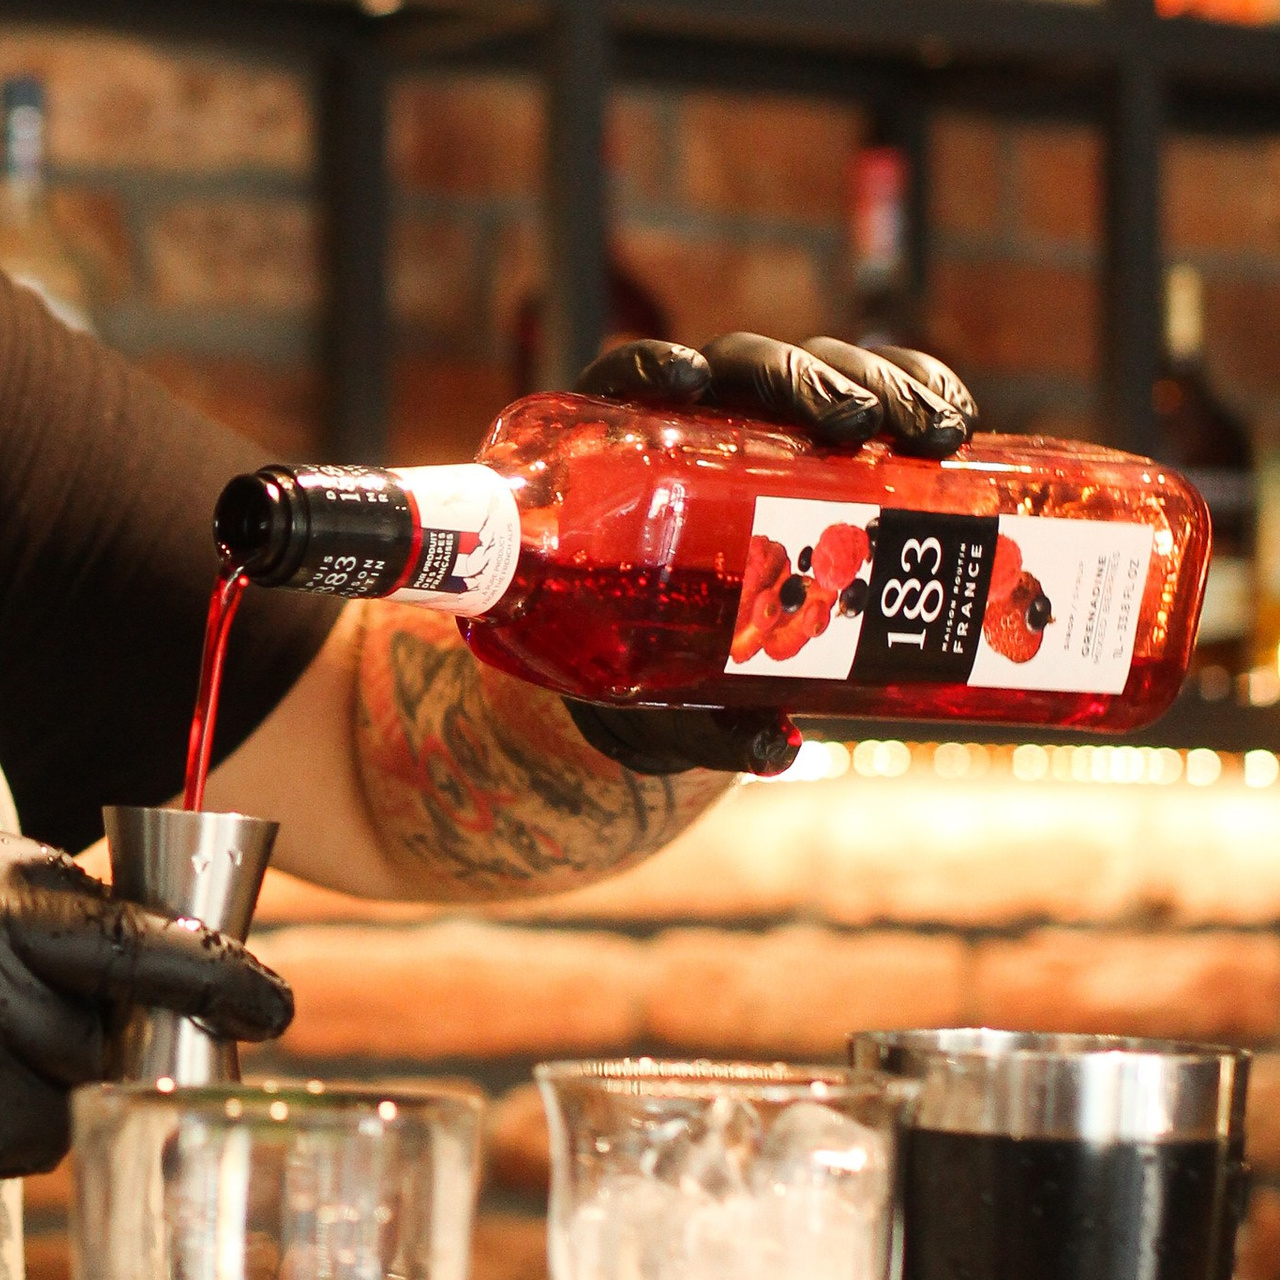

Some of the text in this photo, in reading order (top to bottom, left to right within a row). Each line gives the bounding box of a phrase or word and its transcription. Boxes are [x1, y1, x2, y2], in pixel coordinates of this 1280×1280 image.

[311, 556, 357, 596] 883
[339, 559, 374, 597] AISON
[348, 560, 386, 598] OUTIN
[413, 532, 438, 588] PUR PRODUIT
[421, 532, 446, 589] DES ALPES
[429, 533, 454, 589] FRANÇAISES
[494, 536, 505, 573] PRODUCT
[1127, 559, 1140, 580] OZ
[942, 542, 967, 652] MAISON ROUTIN
[953, 544, 983, 653] FRANCE
[1081, 555, 1107, 657] GRENADINE
[1093, 551, 1121, 664] MIXED BERRIES
[1123, 582, 1135, 601] FL
